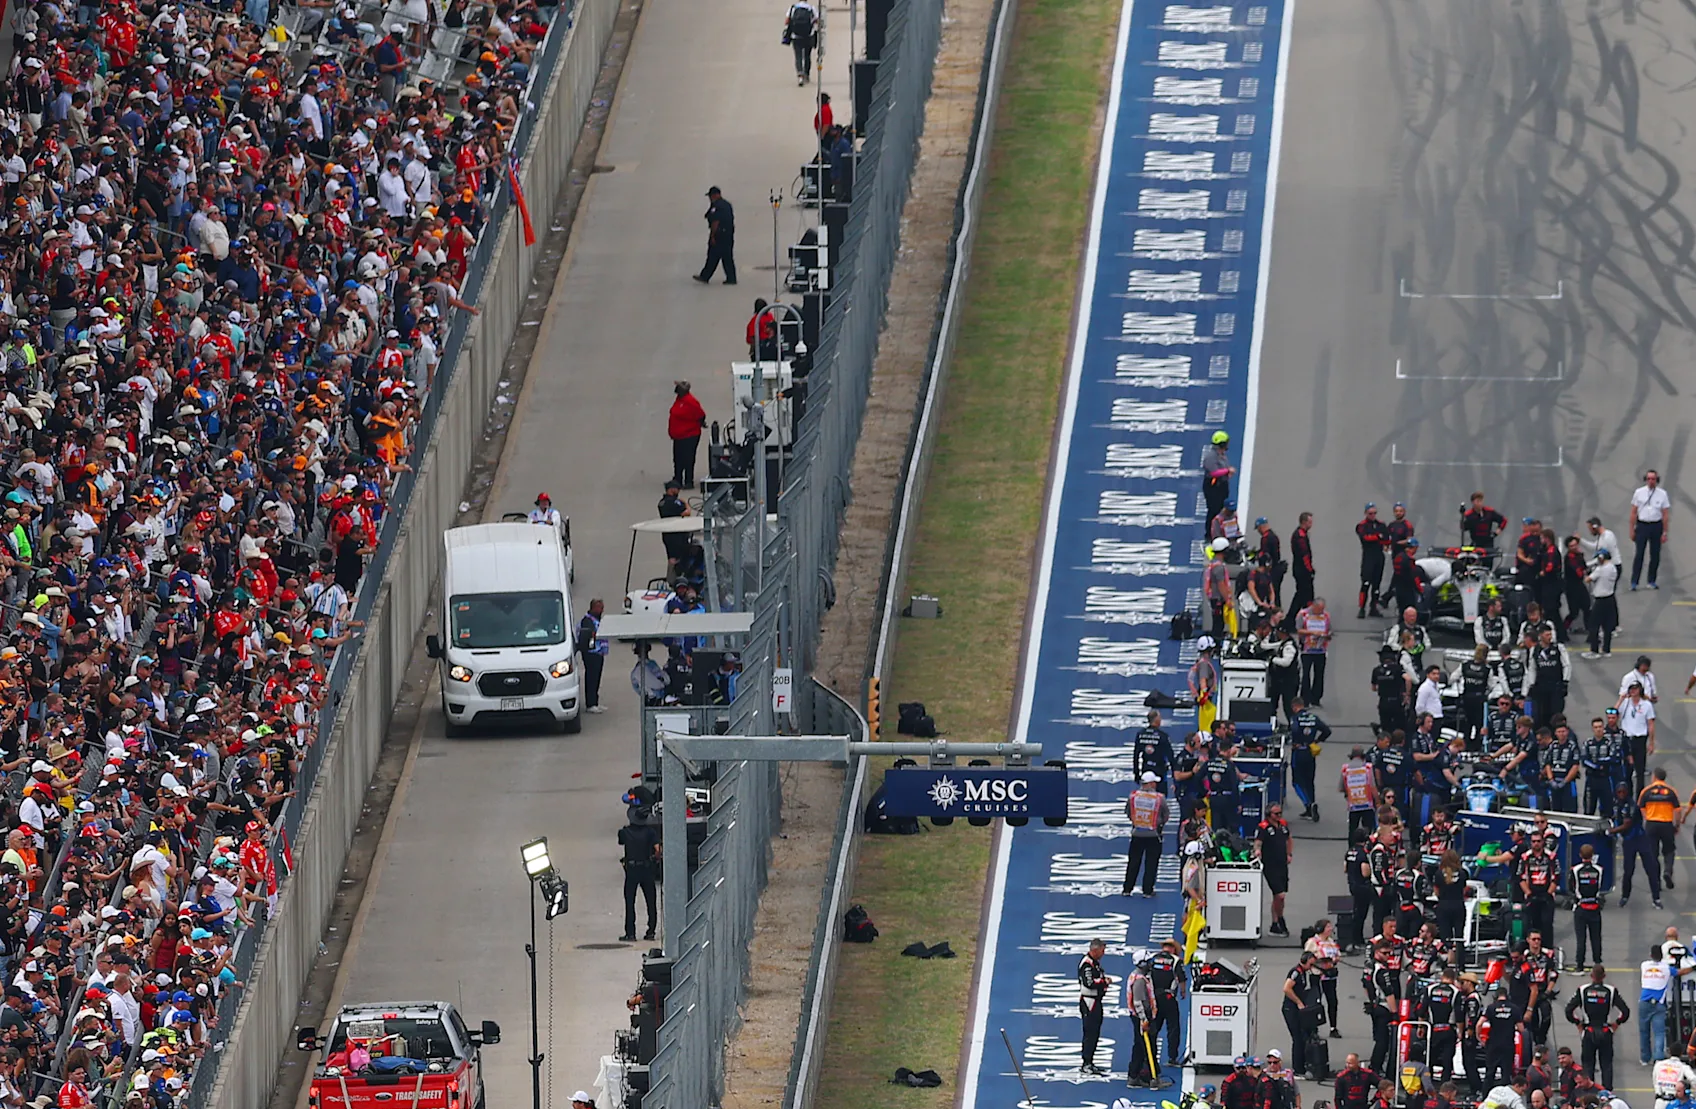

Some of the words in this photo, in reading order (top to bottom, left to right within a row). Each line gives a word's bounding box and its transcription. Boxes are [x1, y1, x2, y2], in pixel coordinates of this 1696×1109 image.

[774, 676, 790, 684] 20B
[1234, 686, 1255, 698] 77
[777, 695, 785, 707] F
[963, 779, 1028, 802] MSC
[963, 803, 1029, 813] CRUISES
[1217, 882, 1251, 892] EO31
[1200, 1005, 1238, 1017] OB87
[418, 1090, 443, 1100] SAFETY
